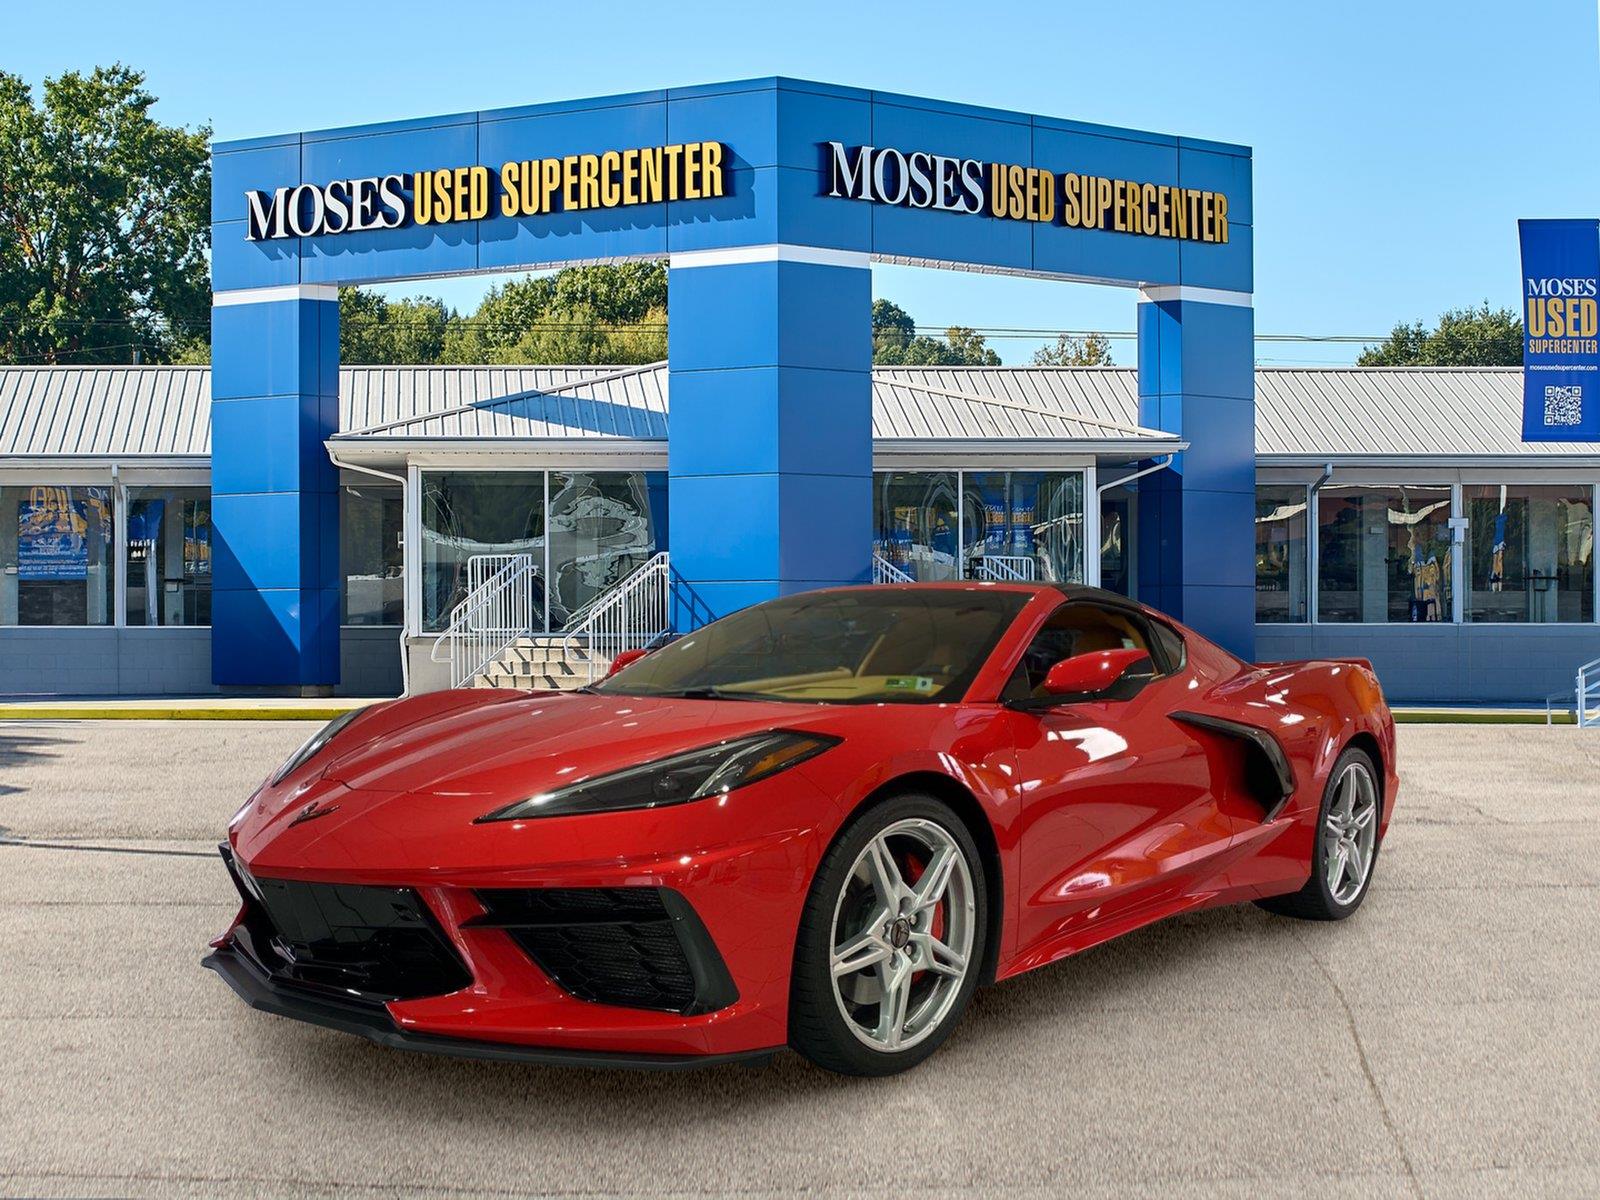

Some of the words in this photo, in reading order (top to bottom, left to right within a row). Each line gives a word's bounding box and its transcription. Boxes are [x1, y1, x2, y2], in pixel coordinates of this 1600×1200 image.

[244, 174, 407, 241] MOSES
[413, 166, 488, 226] USED
[499, 140, 723, 217] SUPERCENTER
[829, 141, 984, 214] MOSES
[991, 163, 1055, 222] USED
[1064, 172, 1229, 244] SUPERCENTER
[1527, 278, 1597, 296] MOSES
[1528, 297, 1598, 338] USED
[1529, 339, 1598, 354] SUPERCENTER
